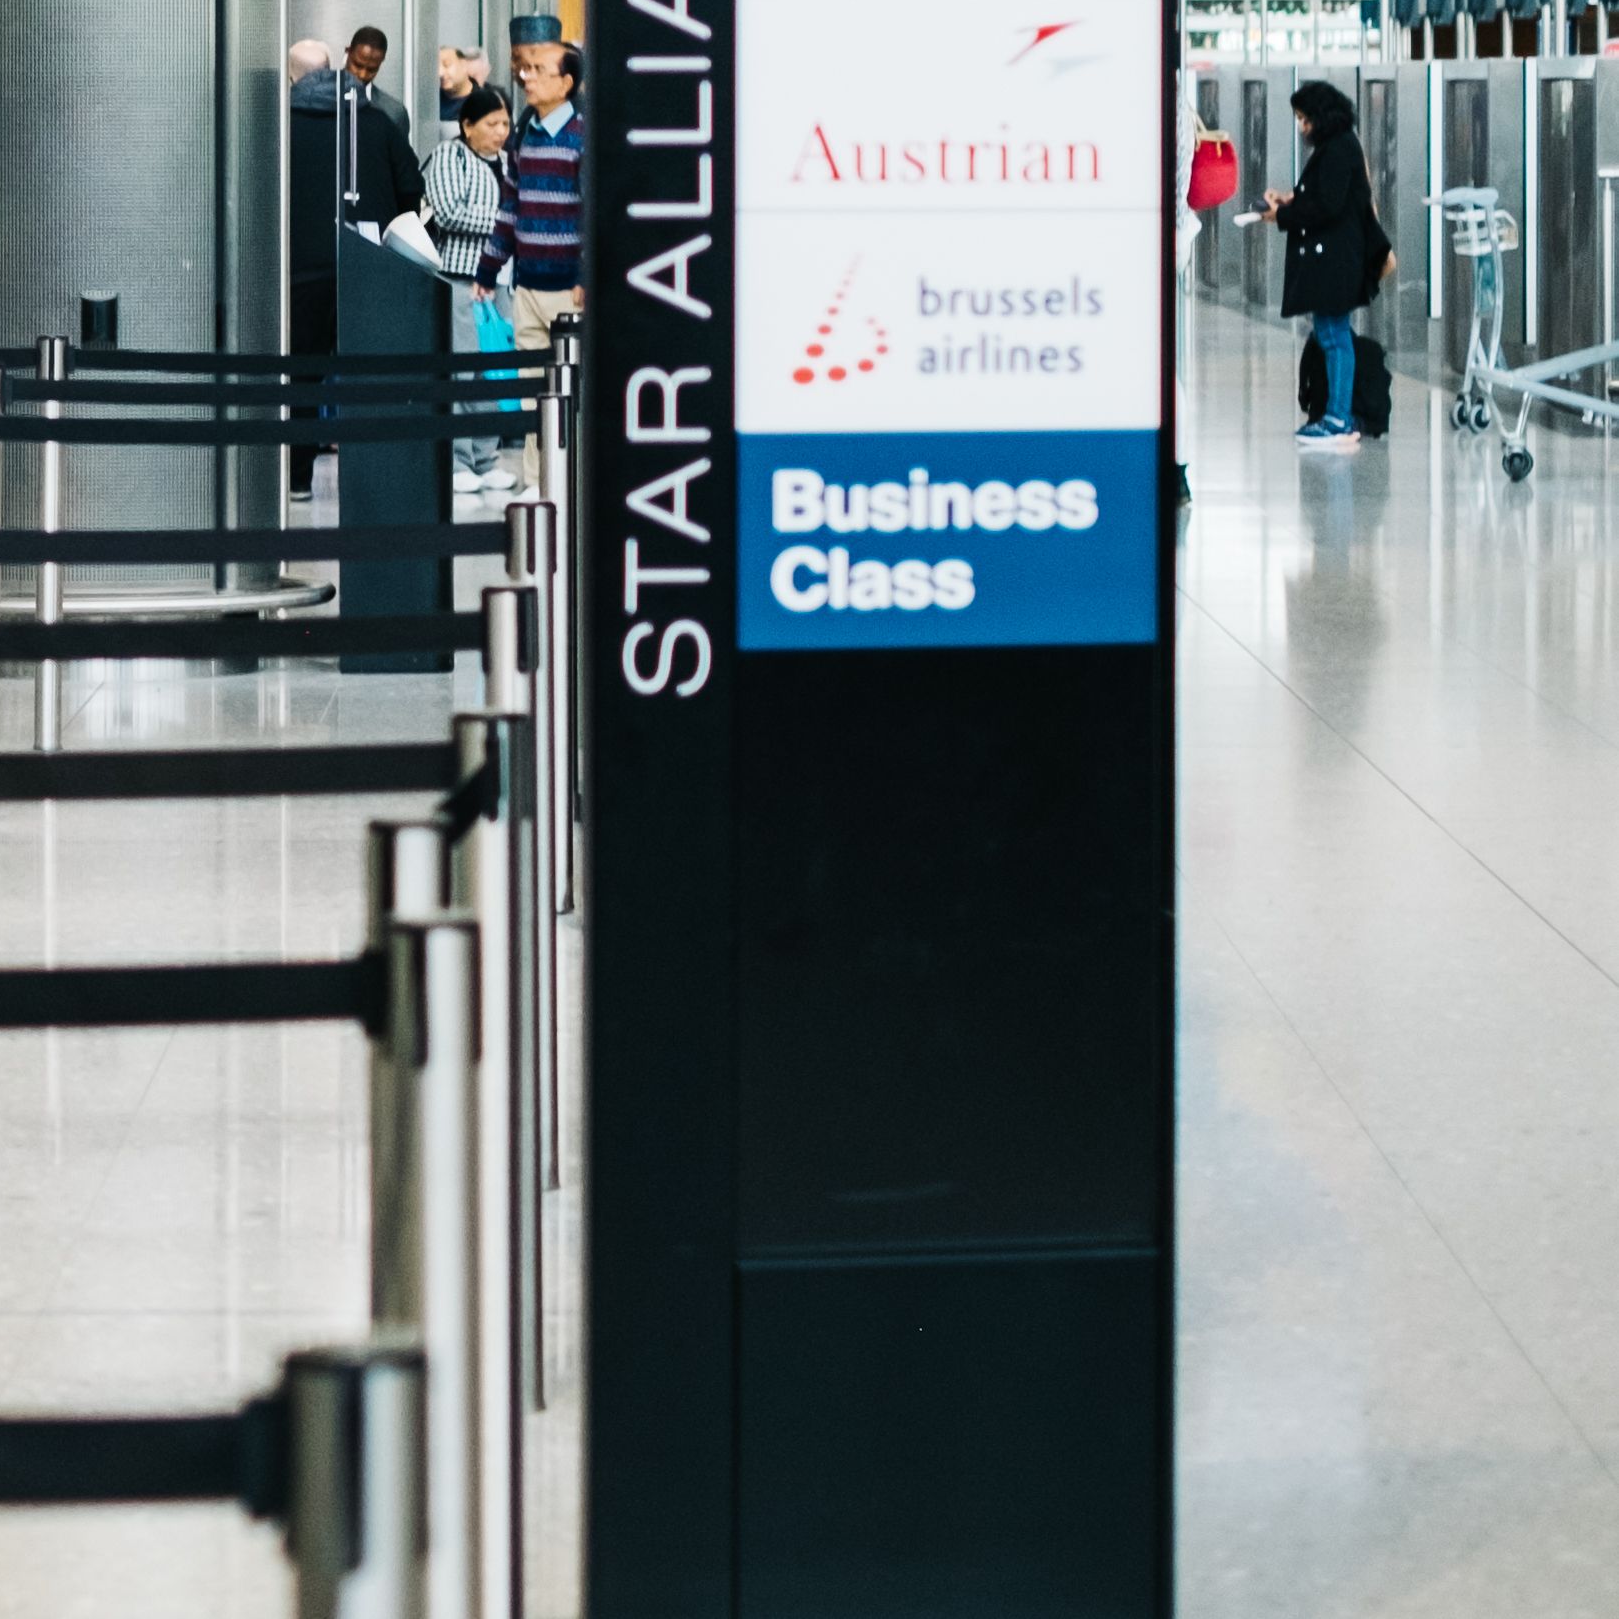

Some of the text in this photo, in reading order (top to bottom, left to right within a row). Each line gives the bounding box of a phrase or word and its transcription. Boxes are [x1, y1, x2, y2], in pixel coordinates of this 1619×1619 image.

[791, 122, 1104, 182] Austrian
[918, 276, 1105, 317] brussels
[917, 333, 1085, 374] airlines
[771, 467, 1099, 533] Business
[622, 366, 712, 698] STAR
[770, 545, 976, 614] Class
